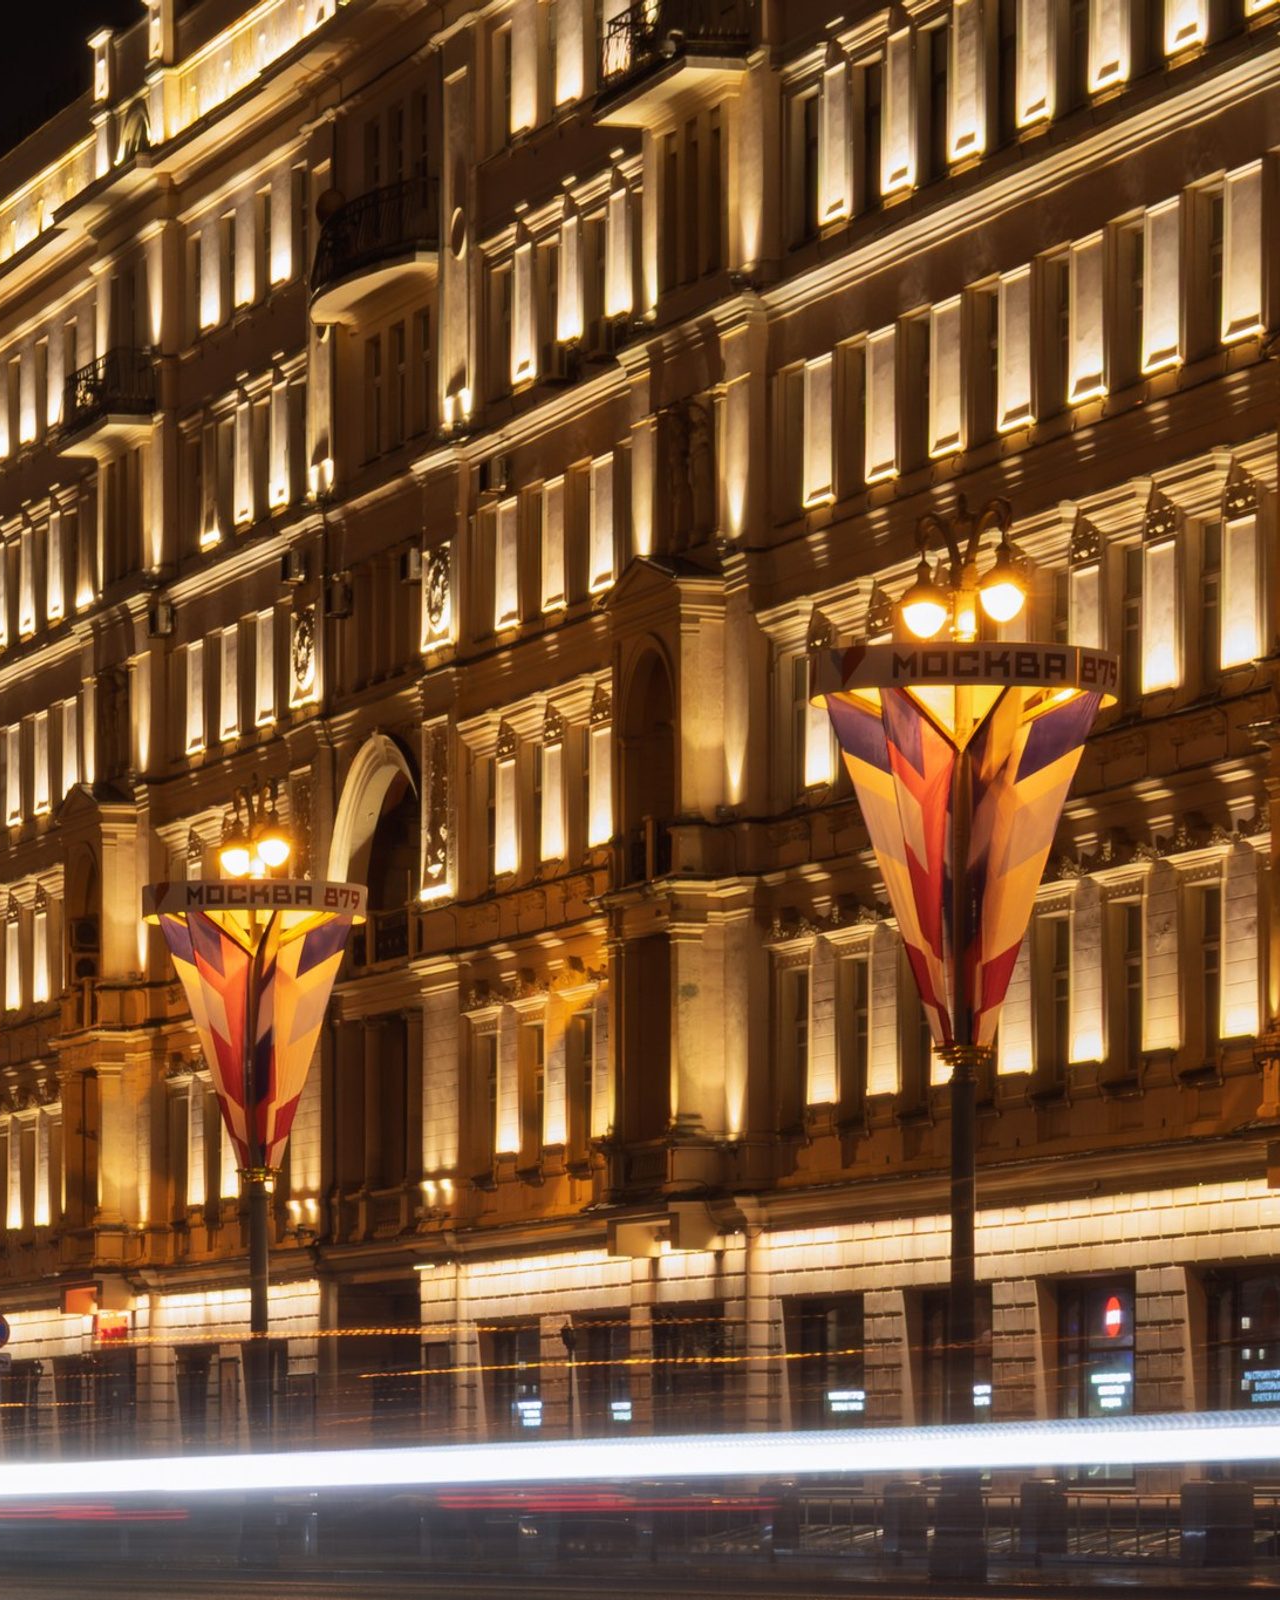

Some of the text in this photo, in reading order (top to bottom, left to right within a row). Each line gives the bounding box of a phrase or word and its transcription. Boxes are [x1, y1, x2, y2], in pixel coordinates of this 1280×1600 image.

[892, 650, 1118, 688] МОСКВА 879
[186, 884, 361, 910] МОСКВА 879
